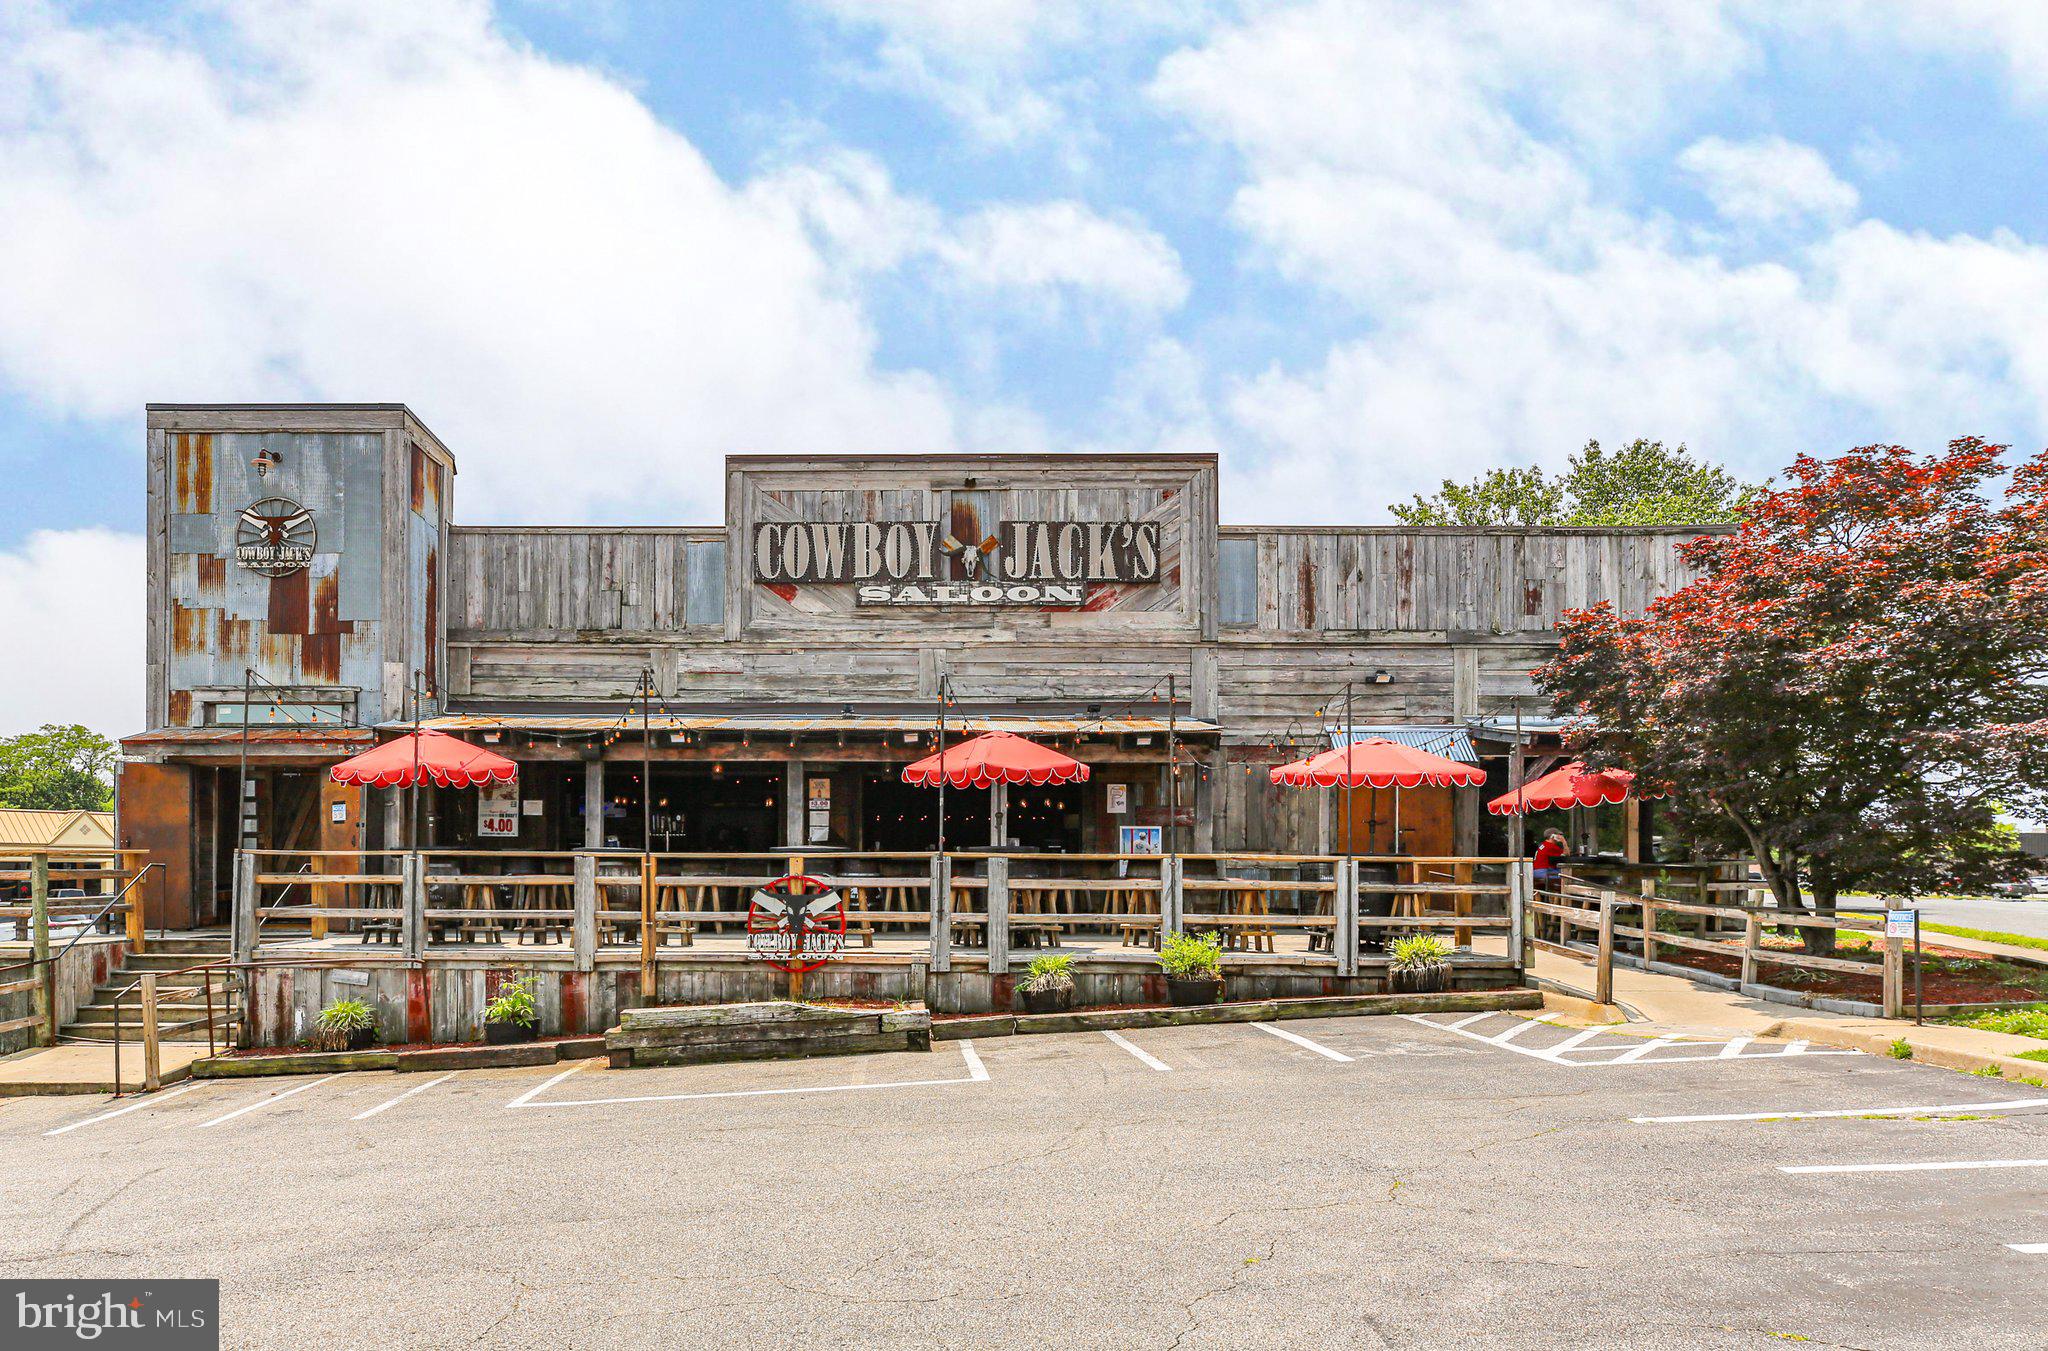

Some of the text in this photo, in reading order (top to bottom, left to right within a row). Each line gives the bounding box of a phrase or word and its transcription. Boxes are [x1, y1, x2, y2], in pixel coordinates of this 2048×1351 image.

[236, 546, 311, 560] COWBOY JACK'S
[757, 523, 1158, 579] COWBOY JACK'S
[857, 585, 1083, 602] SALOON
[483, 818, 513, 832] $4.00
[747, 933, 845, 950] COWBOY JACK'S
[747, 952, 844, 960] SALOON
